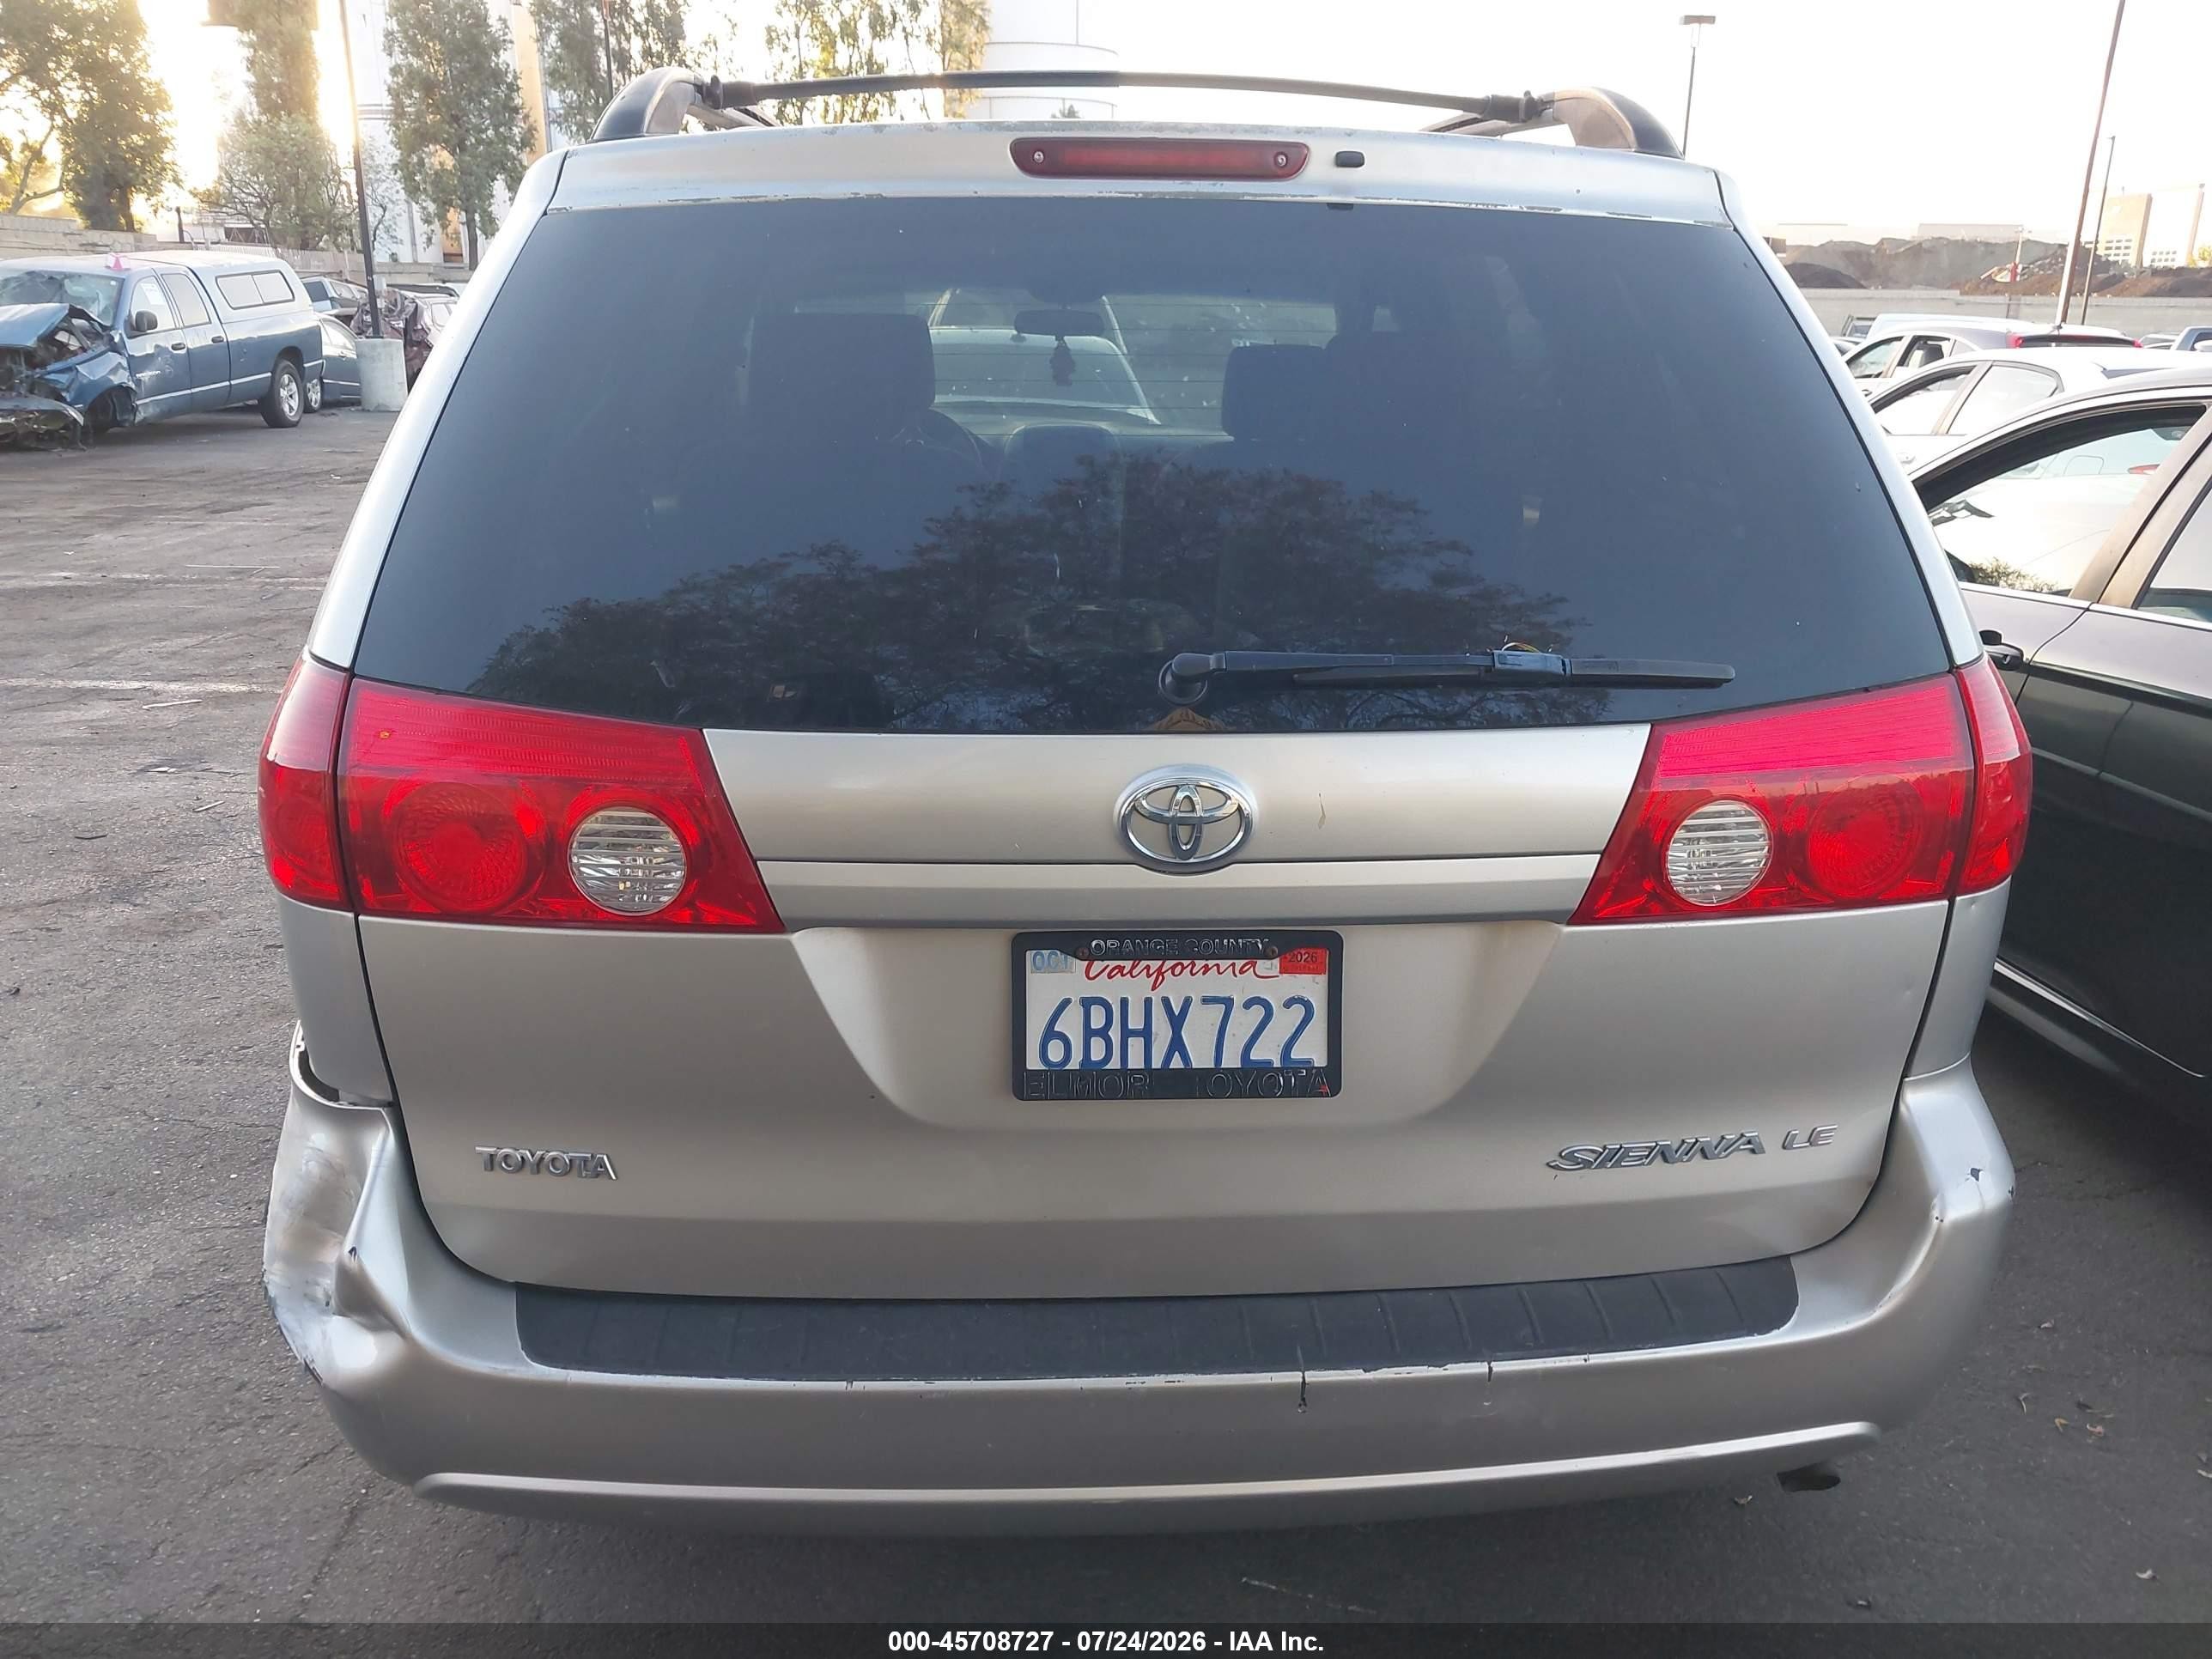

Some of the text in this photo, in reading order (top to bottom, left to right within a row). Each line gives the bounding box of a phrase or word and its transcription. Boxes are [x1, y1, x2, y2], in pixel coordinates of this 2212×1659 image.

[1090, 938, 1269, 956] ORANGE COUNTY
[1290, 951, 1318, 963] 2026
[1084, 958, 1279, 992] California
[1039, 996, 1316, 1070] 6BHX722
[474, 1146, 617, 1180] TOYOTA
[1547, 1124, 1838, 1170] SIENNA LE
